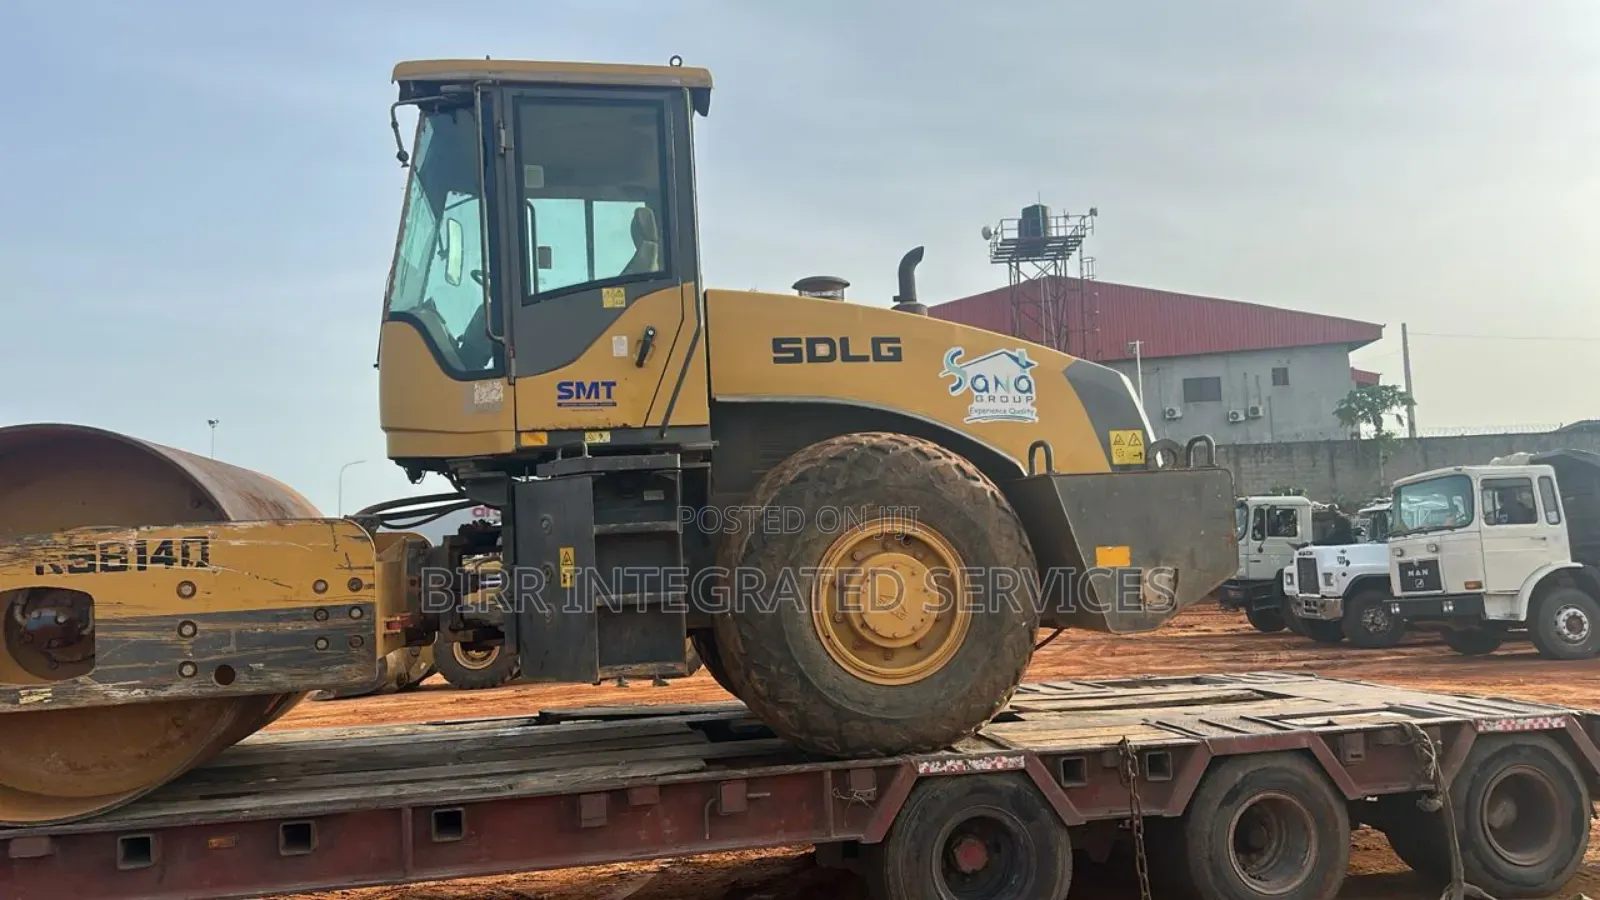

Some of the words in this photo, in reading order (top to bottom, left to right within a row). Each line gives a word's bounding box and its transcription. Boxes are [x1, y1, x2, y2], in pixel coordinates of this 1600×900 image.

[772, 336, 902, 364] SDLG
[557, 381, 617, 400] SMT
[975, 395, 1034, 403] GROUP
[969, 407, 1007, 415] Experience
[1008, 407, 1034, 416] Quality
